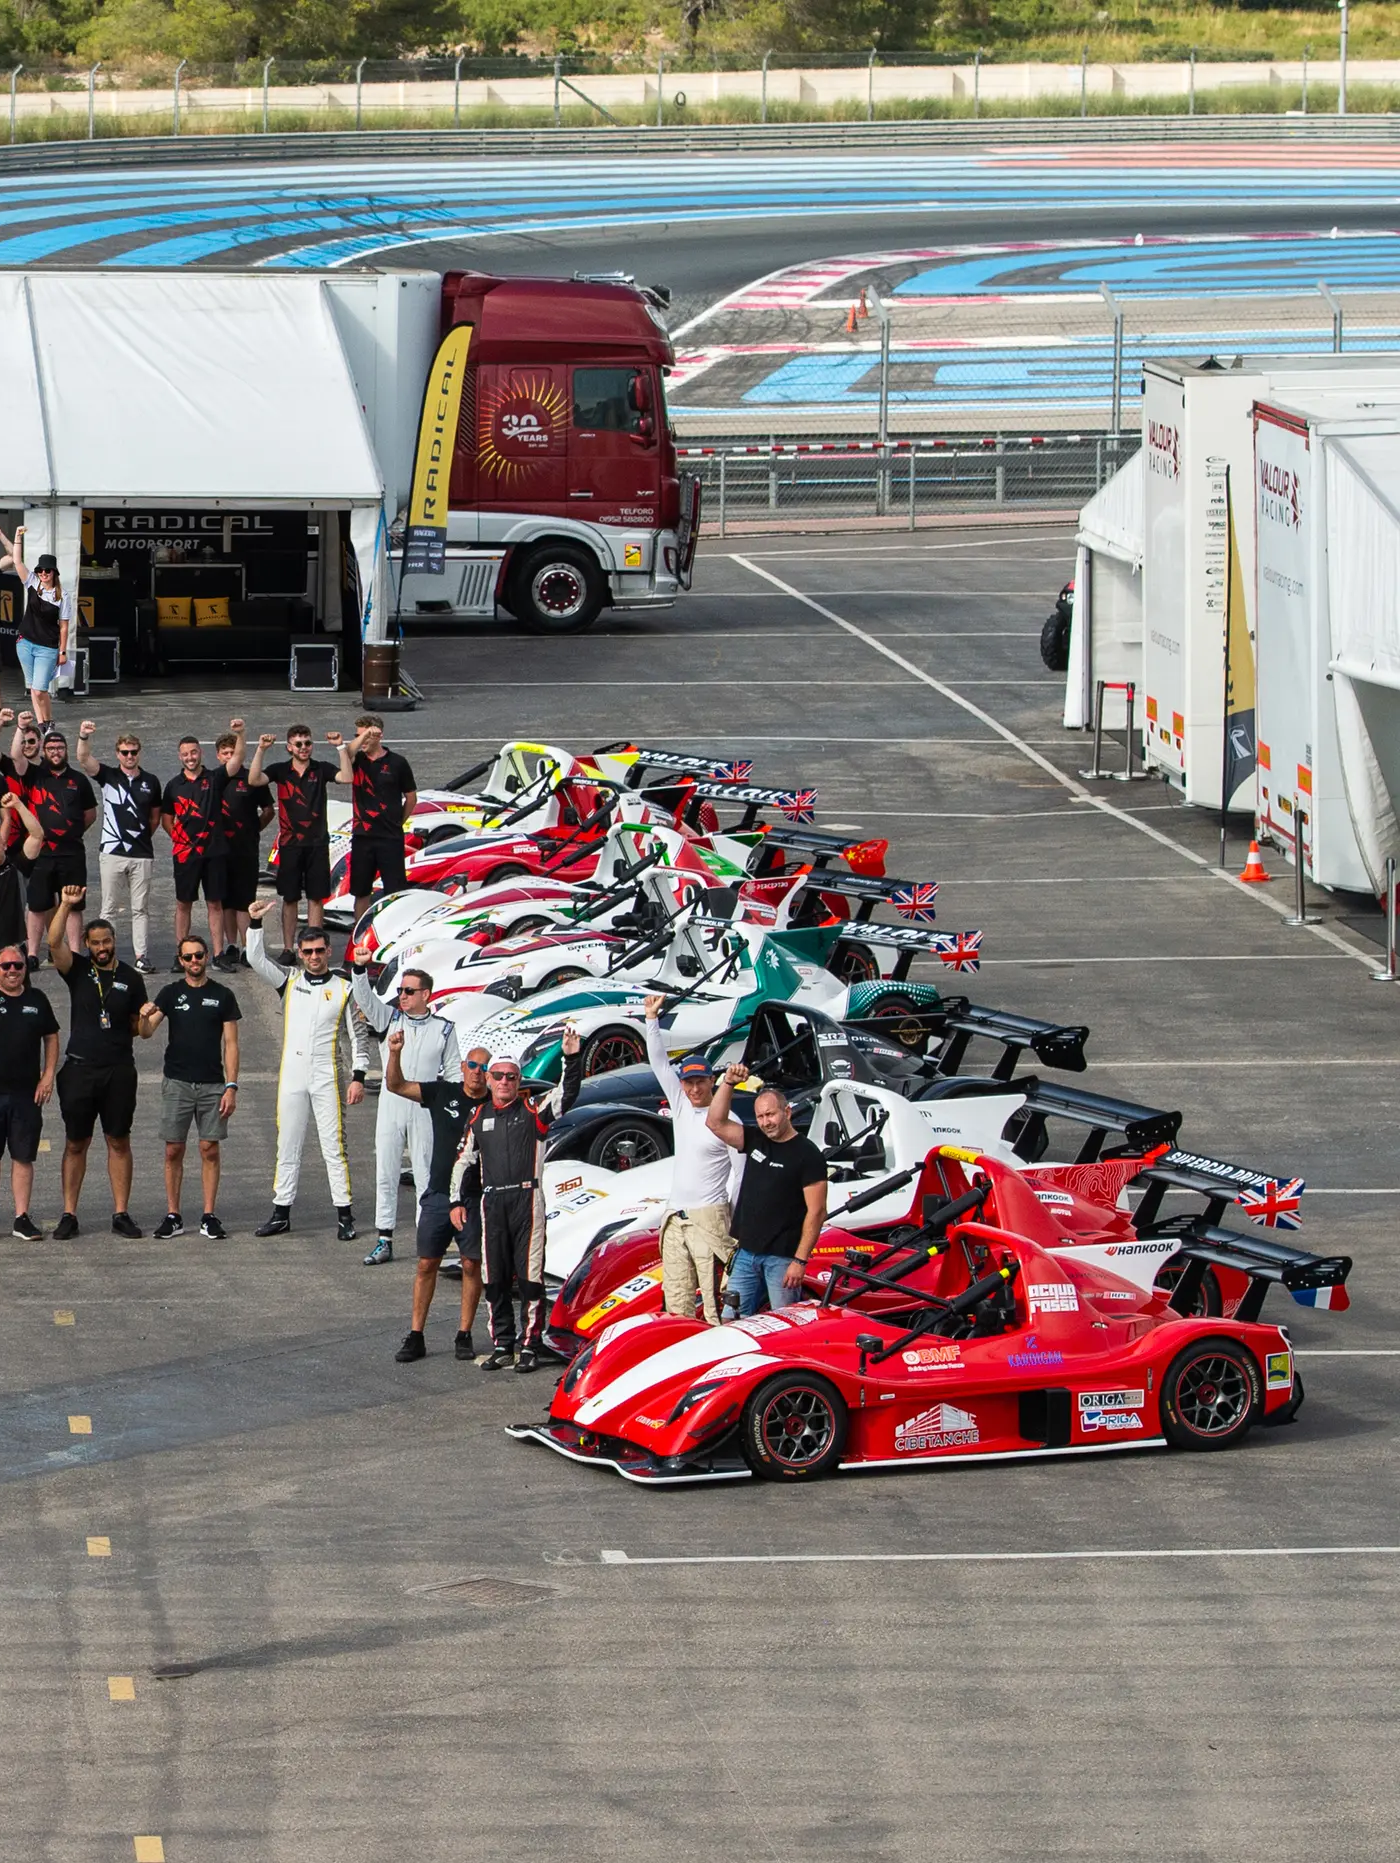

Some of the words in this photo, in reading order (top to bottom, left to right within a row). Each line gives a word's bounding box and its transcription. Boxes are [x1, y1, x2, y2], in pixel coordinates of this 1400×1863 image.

[423, 348, 458, 520] RADICAL
[517, 434, 548, 443] YEARS
[1148, 419, 1173, 452] VALOUR
[1149, 452, 1173, 479] RACING
[1260, 459, 1290, 498] VALOUR
[620, 507, 654, 515] TELFORD
[1261, 495, 1291, 528] RACING
[104, 515, 274, 530] RADICAL
[104, 538, 200, 550] MOTORSPORT
[817, 1032, 847, 1041] SR3
[1166, 1151, 1234, 1180] SUPERCAR
[570, 1193, 596, 1206] 15
[1051, 1208, 1072, 1216] MOTUL
[625, 1278, 652, 1292] 23
[1028, 1284, 1076, 1299] acqua
[1031, 1298, 1079, 1314] rossa
[917, 1345, 961, 1364] BMF
[1081, 1394, 1125, 1406] ORIGA
[1098, 1413, 1140, 1425] ORIGA
[895, 1430, 980, 1452] CIBETANCHE
